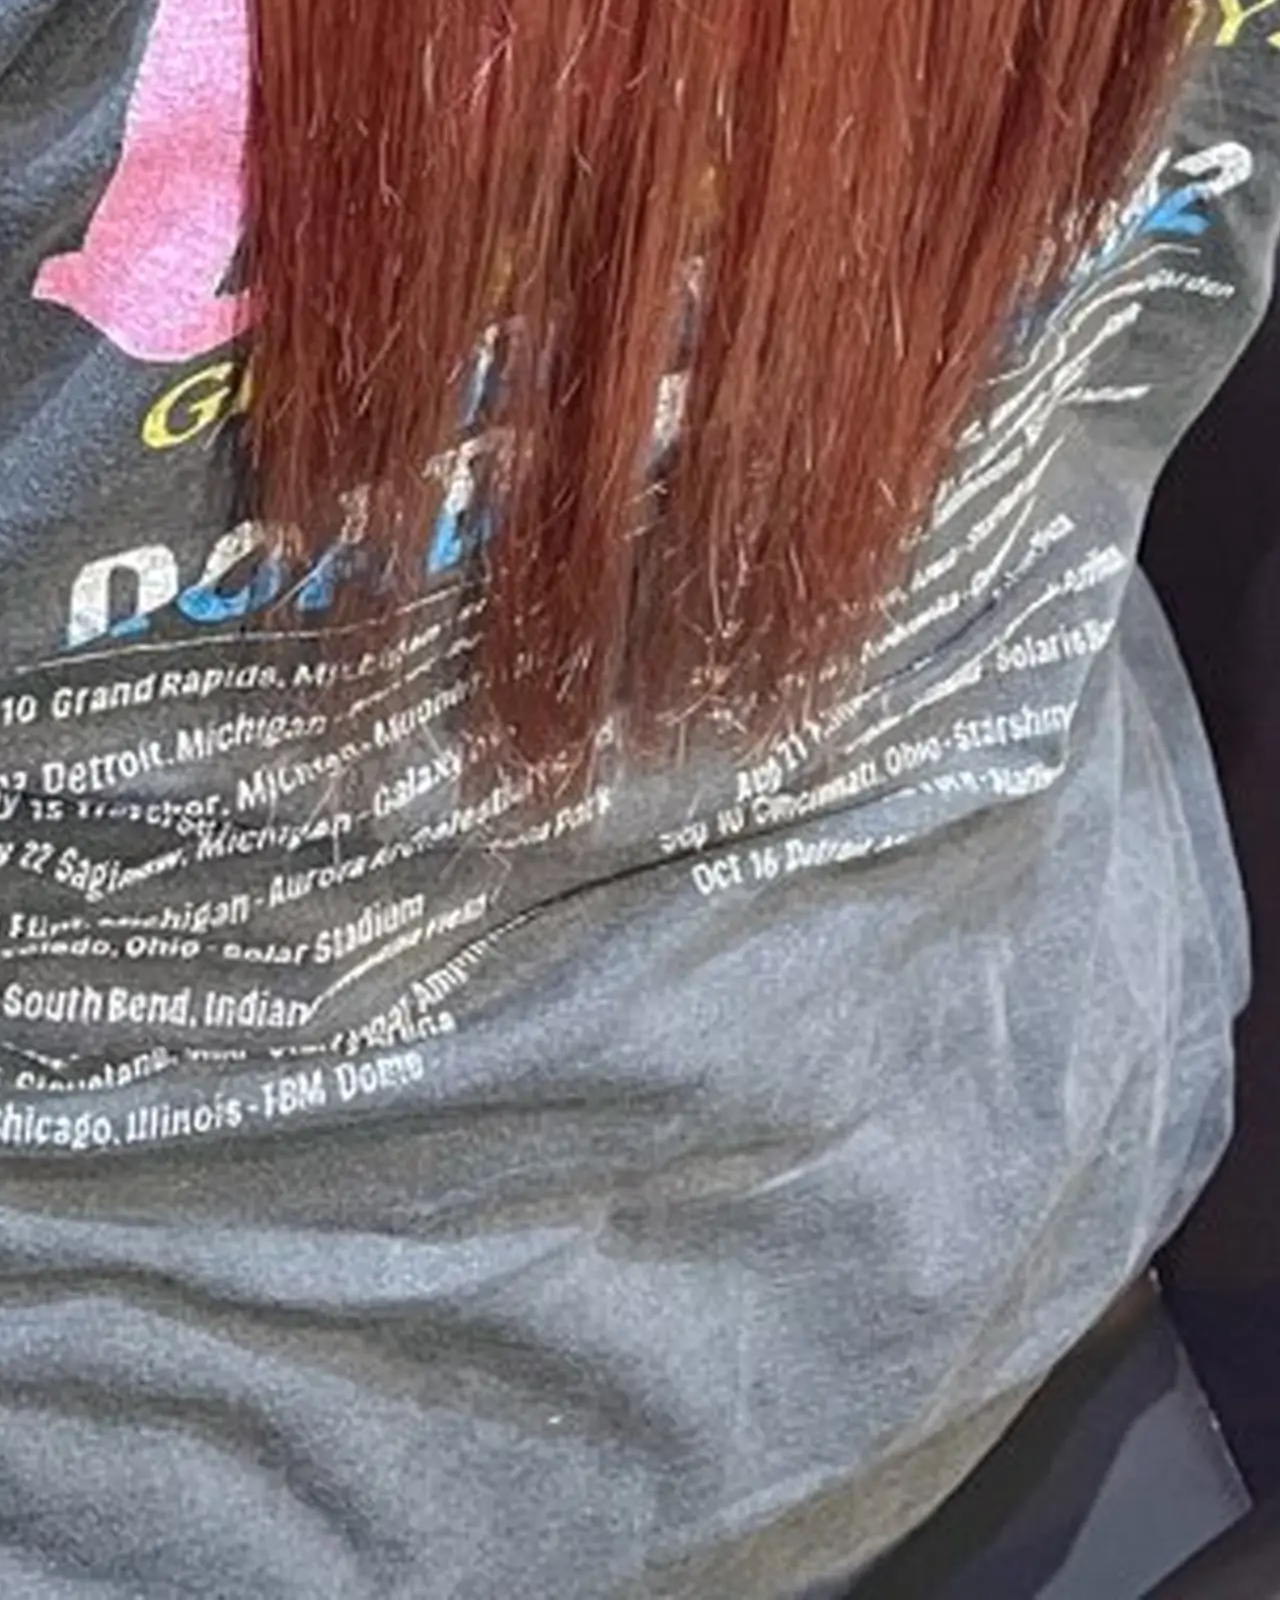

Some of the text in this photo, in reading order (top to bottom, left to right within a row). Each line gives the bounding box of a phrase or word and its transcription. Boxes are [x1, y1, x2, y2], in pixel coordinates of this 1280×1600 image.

[2, 694, 39, 727] 10
[51, 671, 158, 722] Grand
[20, 838, 56, 873] 22
[372, 749, 463, 819] Galaxy
[691, 853, 743, 897] Oct
[750, 847, 780, 880] 16
[313, 893, 426, 965] Stadium
[3, 980, 104, 1026] South
